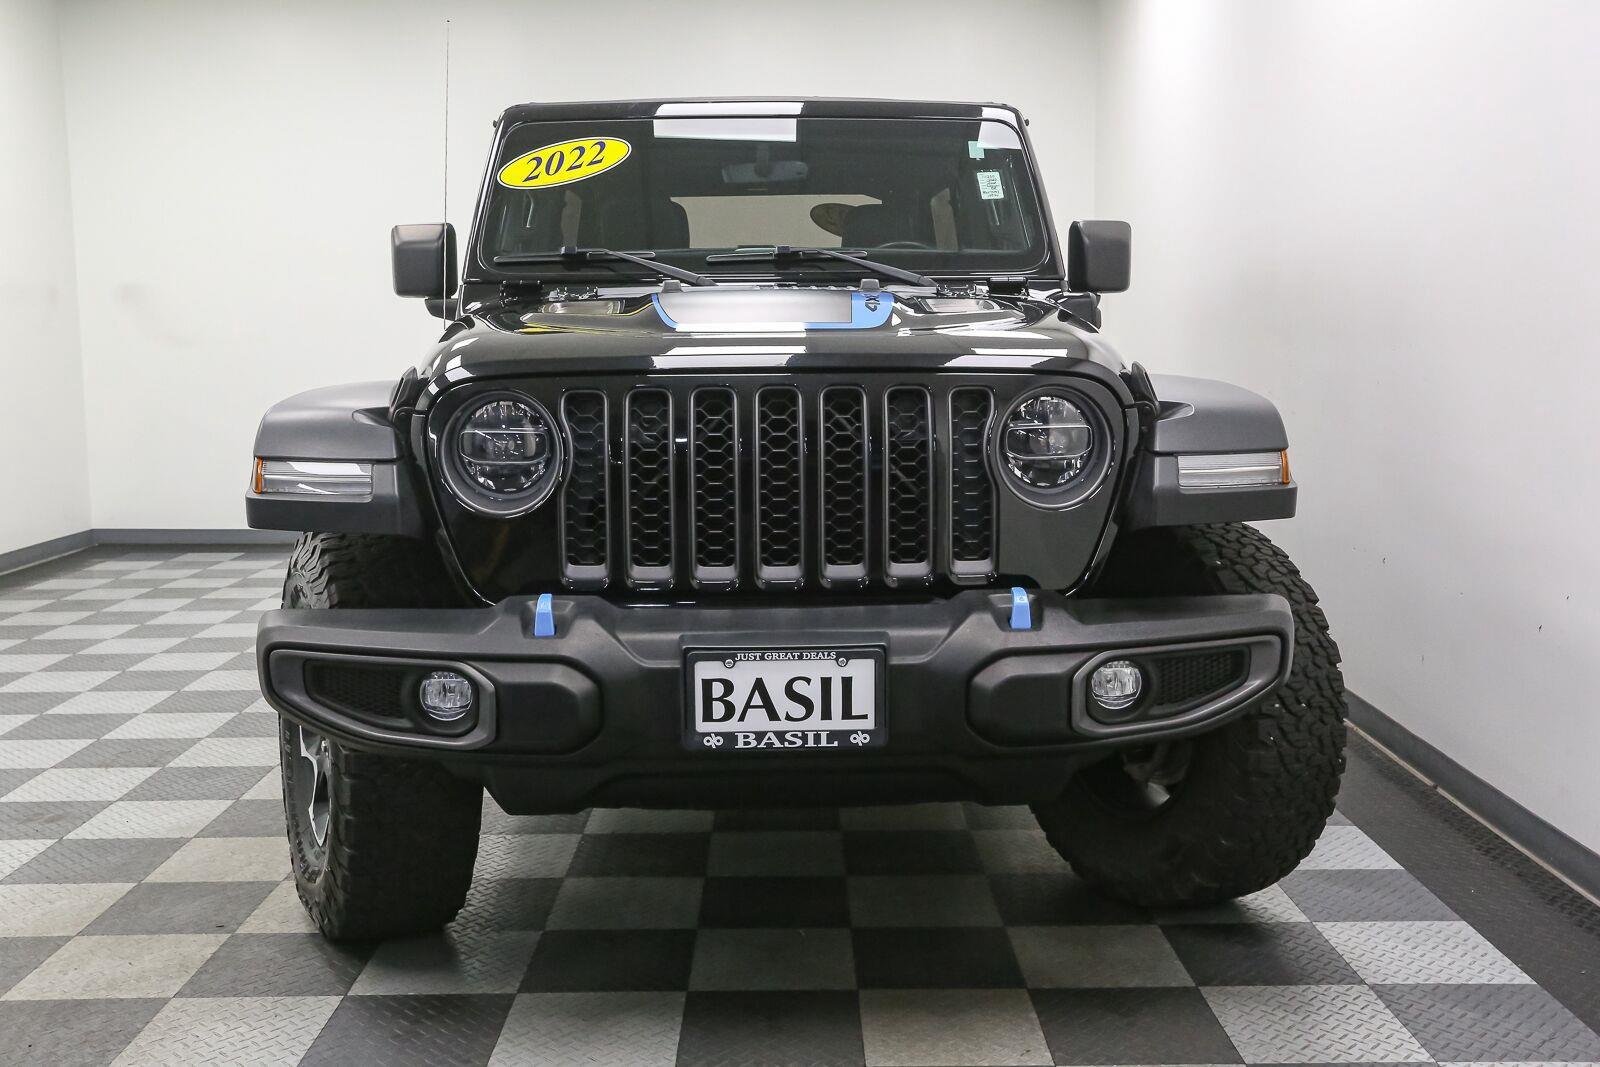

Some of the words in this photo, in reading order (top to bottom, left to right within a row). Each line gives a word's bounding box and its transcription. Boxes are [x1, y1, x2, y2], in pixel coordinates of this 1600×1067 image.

[522, 141, 606, 183] 2022
[735, 653, 762, 661] JUST
[765, 652, 800, 661] GREAT
[803, 652, 836, 660] DEALS
[701, 676, 869, 723] BASIL
[734, 731, 838, 749] BASIL
